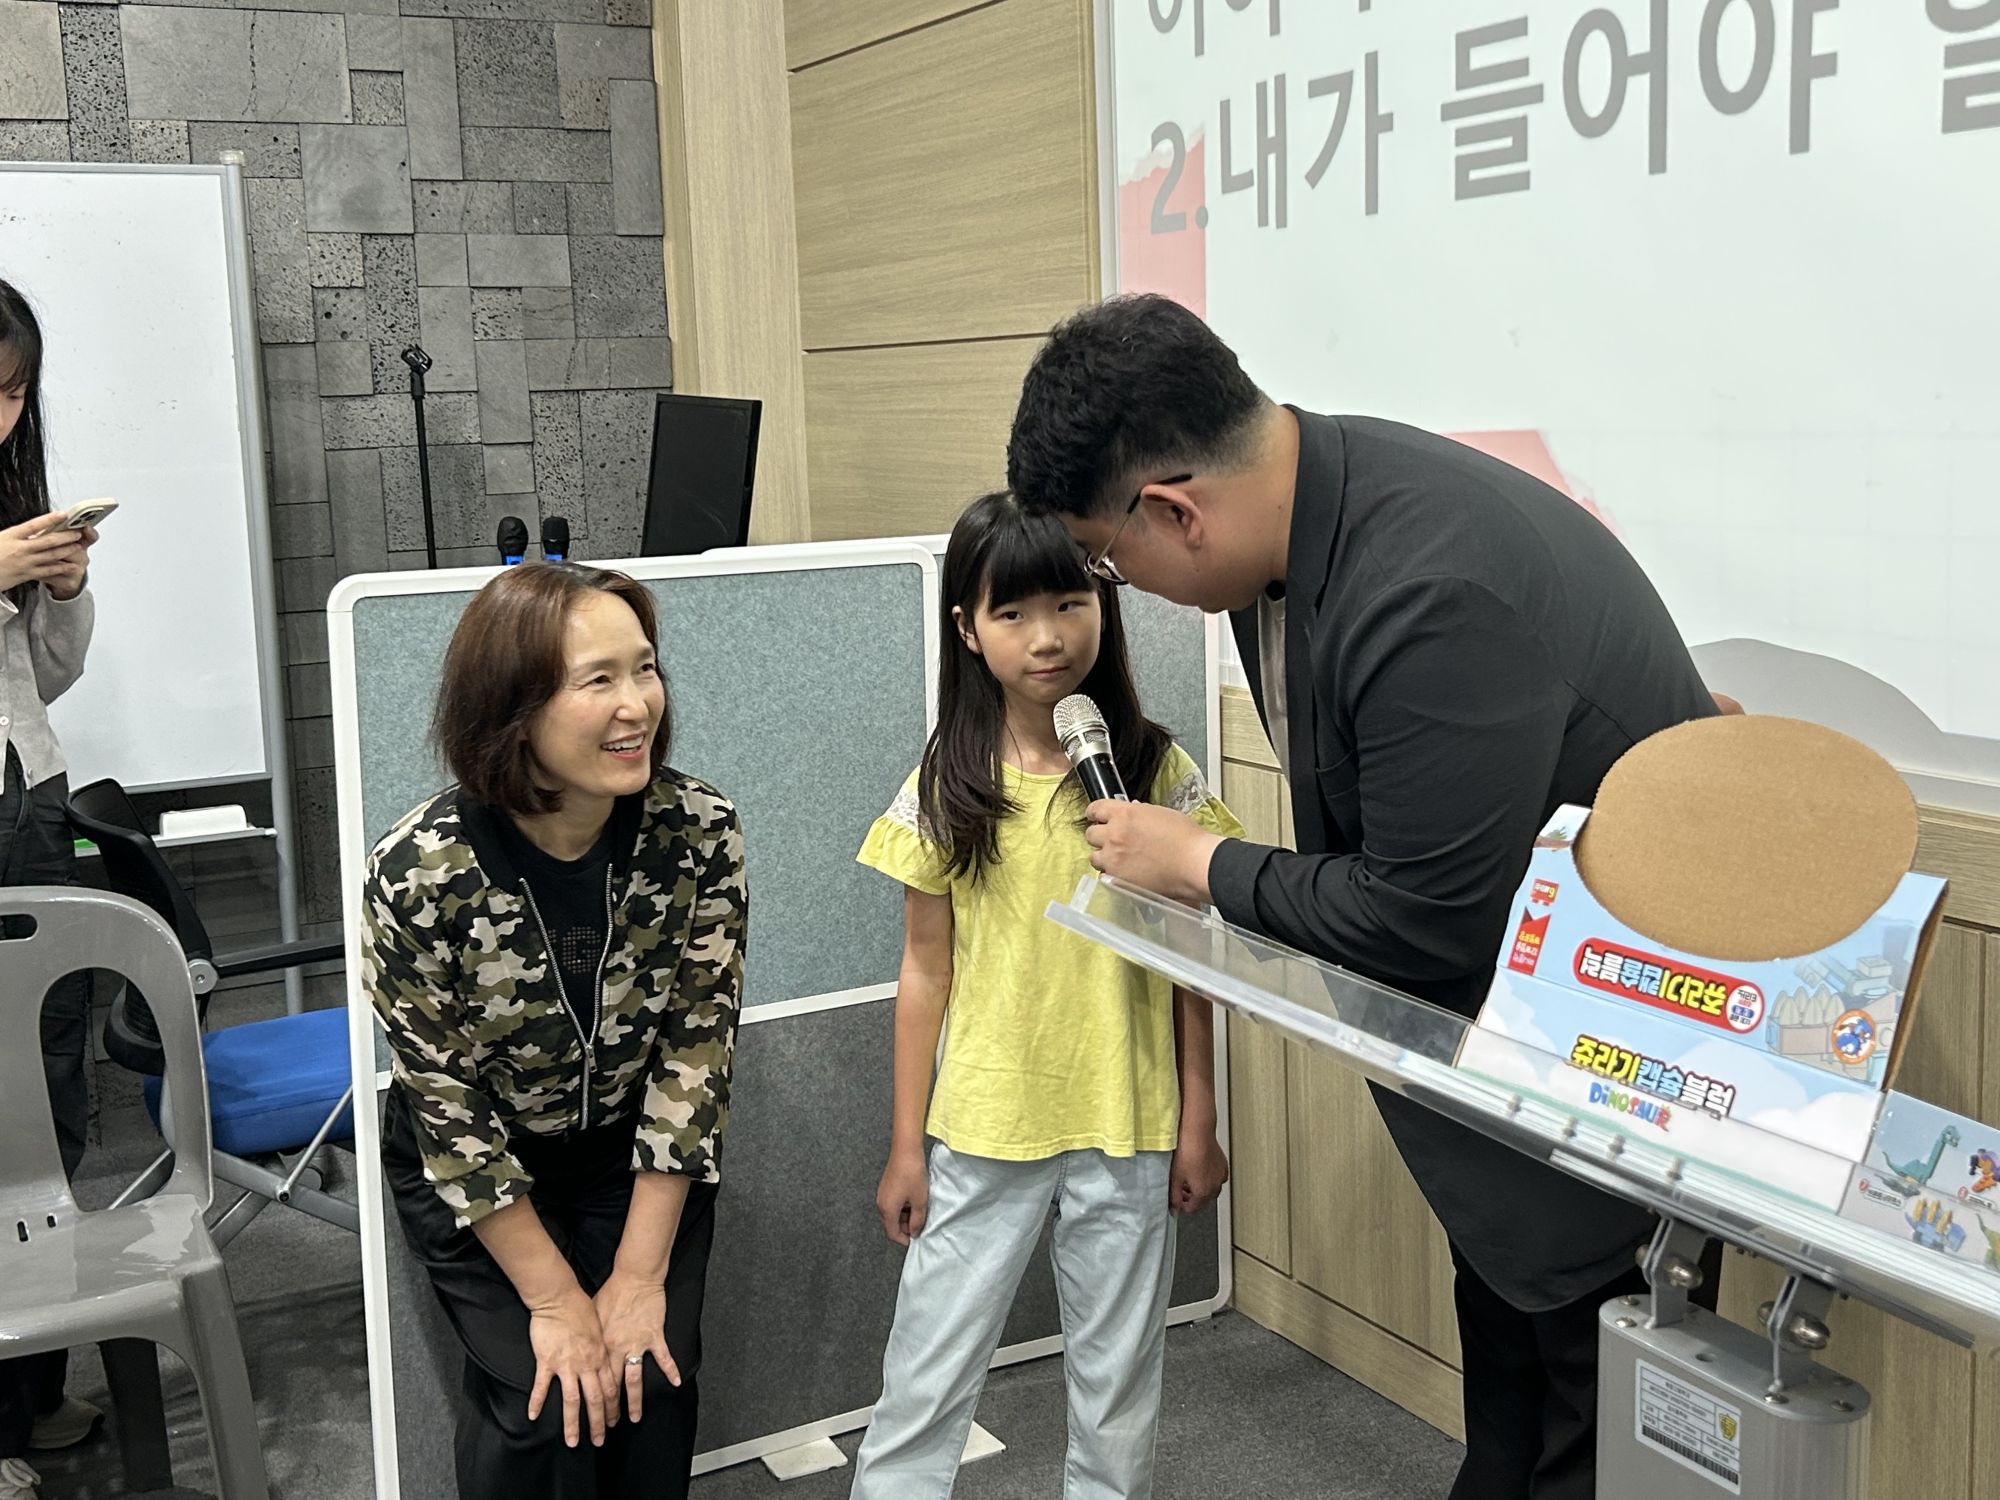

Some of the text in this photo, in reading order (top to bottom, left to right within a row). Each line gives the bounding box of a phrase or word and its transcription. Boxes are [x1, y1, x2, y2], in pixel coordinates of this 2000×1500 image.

[1441, 0, 1838, 200] 들어야
[1579, 944, 1728, 1017] 쥬라기캡슐블럭
[1570, 1034, 1737, 1120] 쥬라기캡슐블럭
